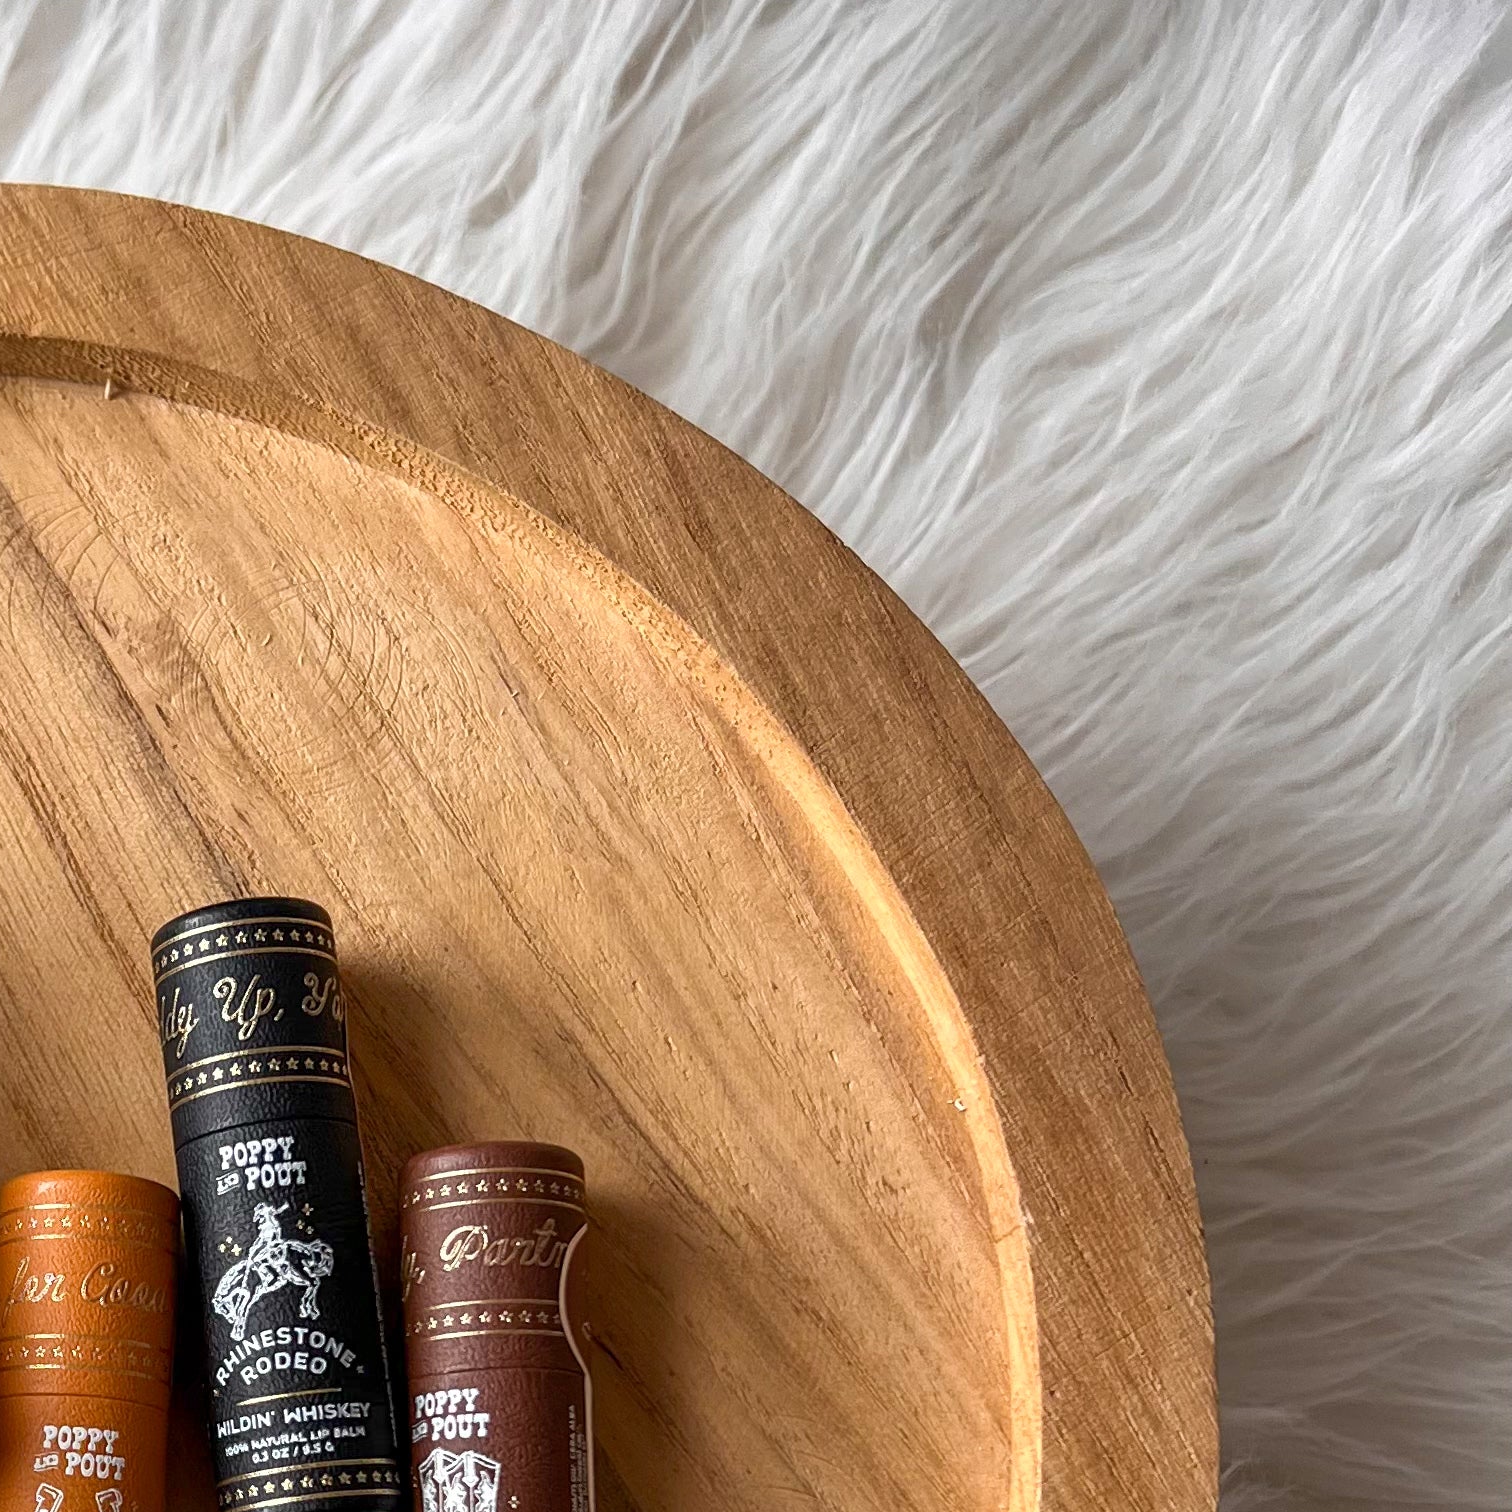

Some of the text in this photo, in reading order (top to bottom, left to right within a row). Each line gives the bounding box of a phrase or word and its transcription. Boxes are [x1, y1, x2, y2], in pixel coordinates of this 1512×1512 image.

[213, 974, 284, 1040] Up,
[218, 1136, 295, 1170] POPPY
[245, 1161, 307, 1191] POUT
[2, 1257, 66, 1328] for
[216, 1327, 356, 1386] RHINESTONE
[240, 1352, 327, 1385] RODEO
[283, 1402, 371, 1424] WHISKEY
[415, 1388, 480, 1419] POPPY
[43, 1425, 118, 1453] POPPY
[251, 1431, 307, 1450] NATURAL
[310, 1429, 330, 1440] LIP
[334, 1425, 366, 1438] BALM
[431, 1413, 490, 1442] POUT
[65, 1452, 125, 1480] POUT
[272, 1447, 290, 1460] OZ
